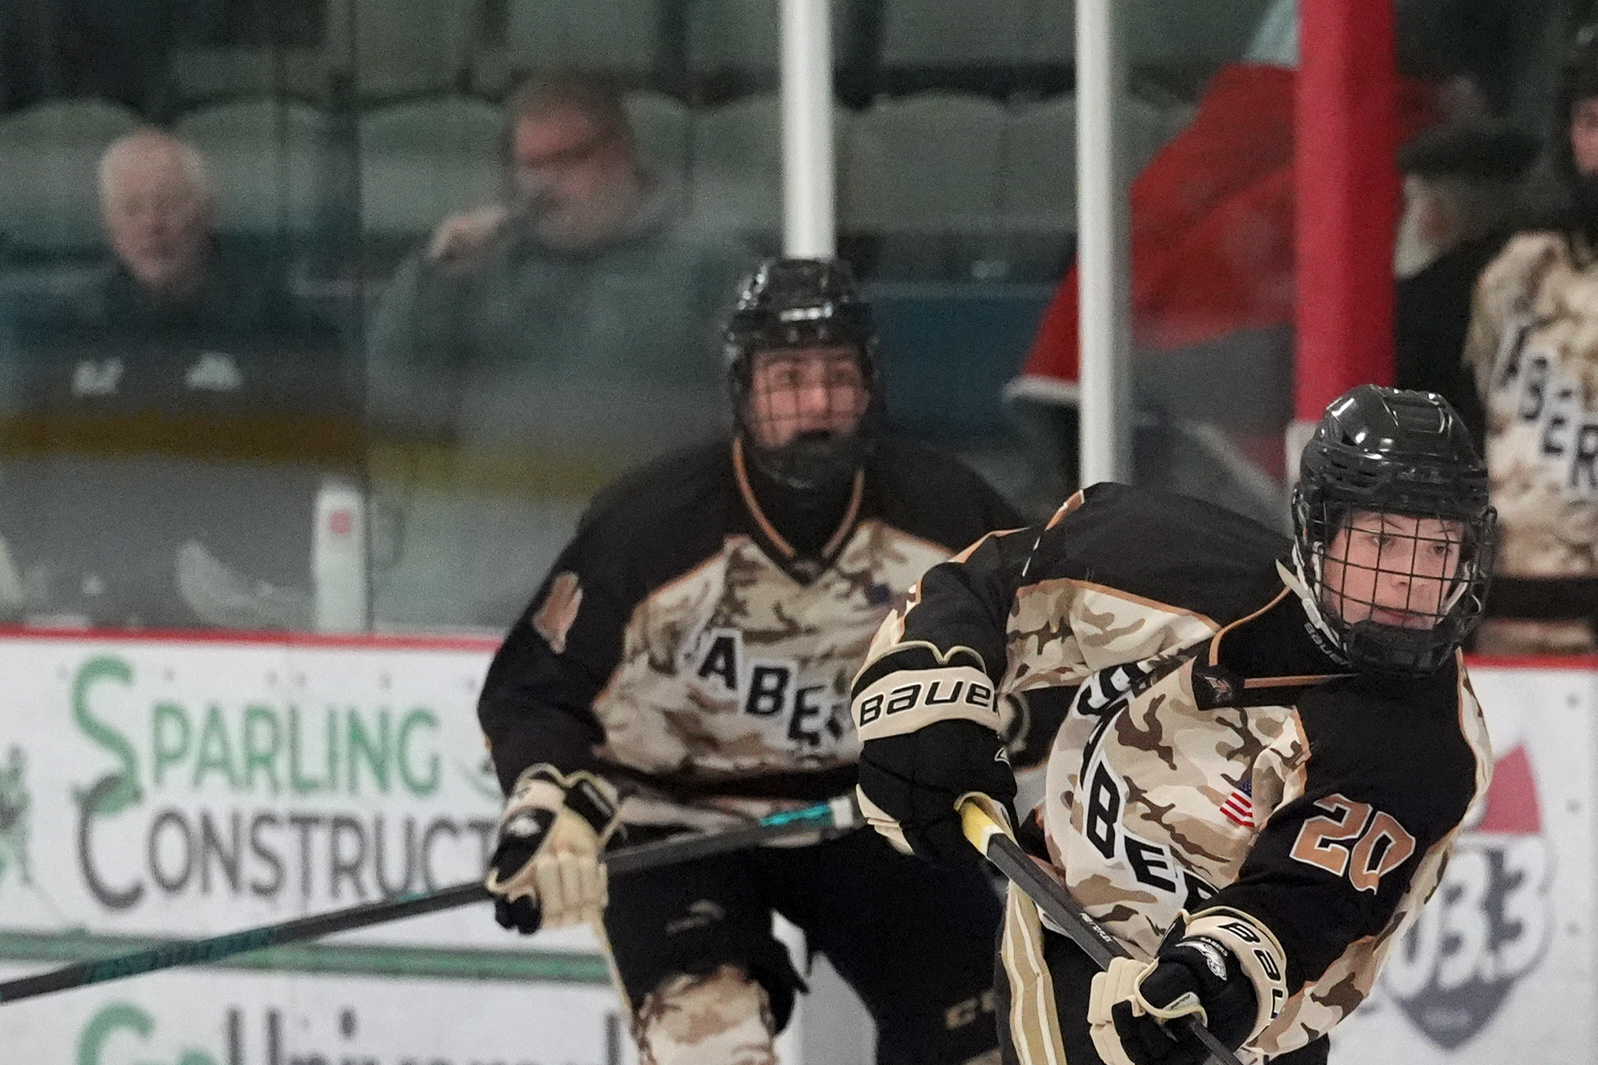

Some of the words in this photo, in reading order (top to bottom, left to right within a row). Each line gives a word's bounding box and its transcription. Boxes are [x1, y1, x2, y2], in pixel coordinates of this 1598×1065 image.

[69, 654, 441, 820] SPARLING
[75, 775, 504, 910] CONSTRUCT
[1288, 792, 1417, 896] 20
[1385, 833, 1552, 1001] 03.3
